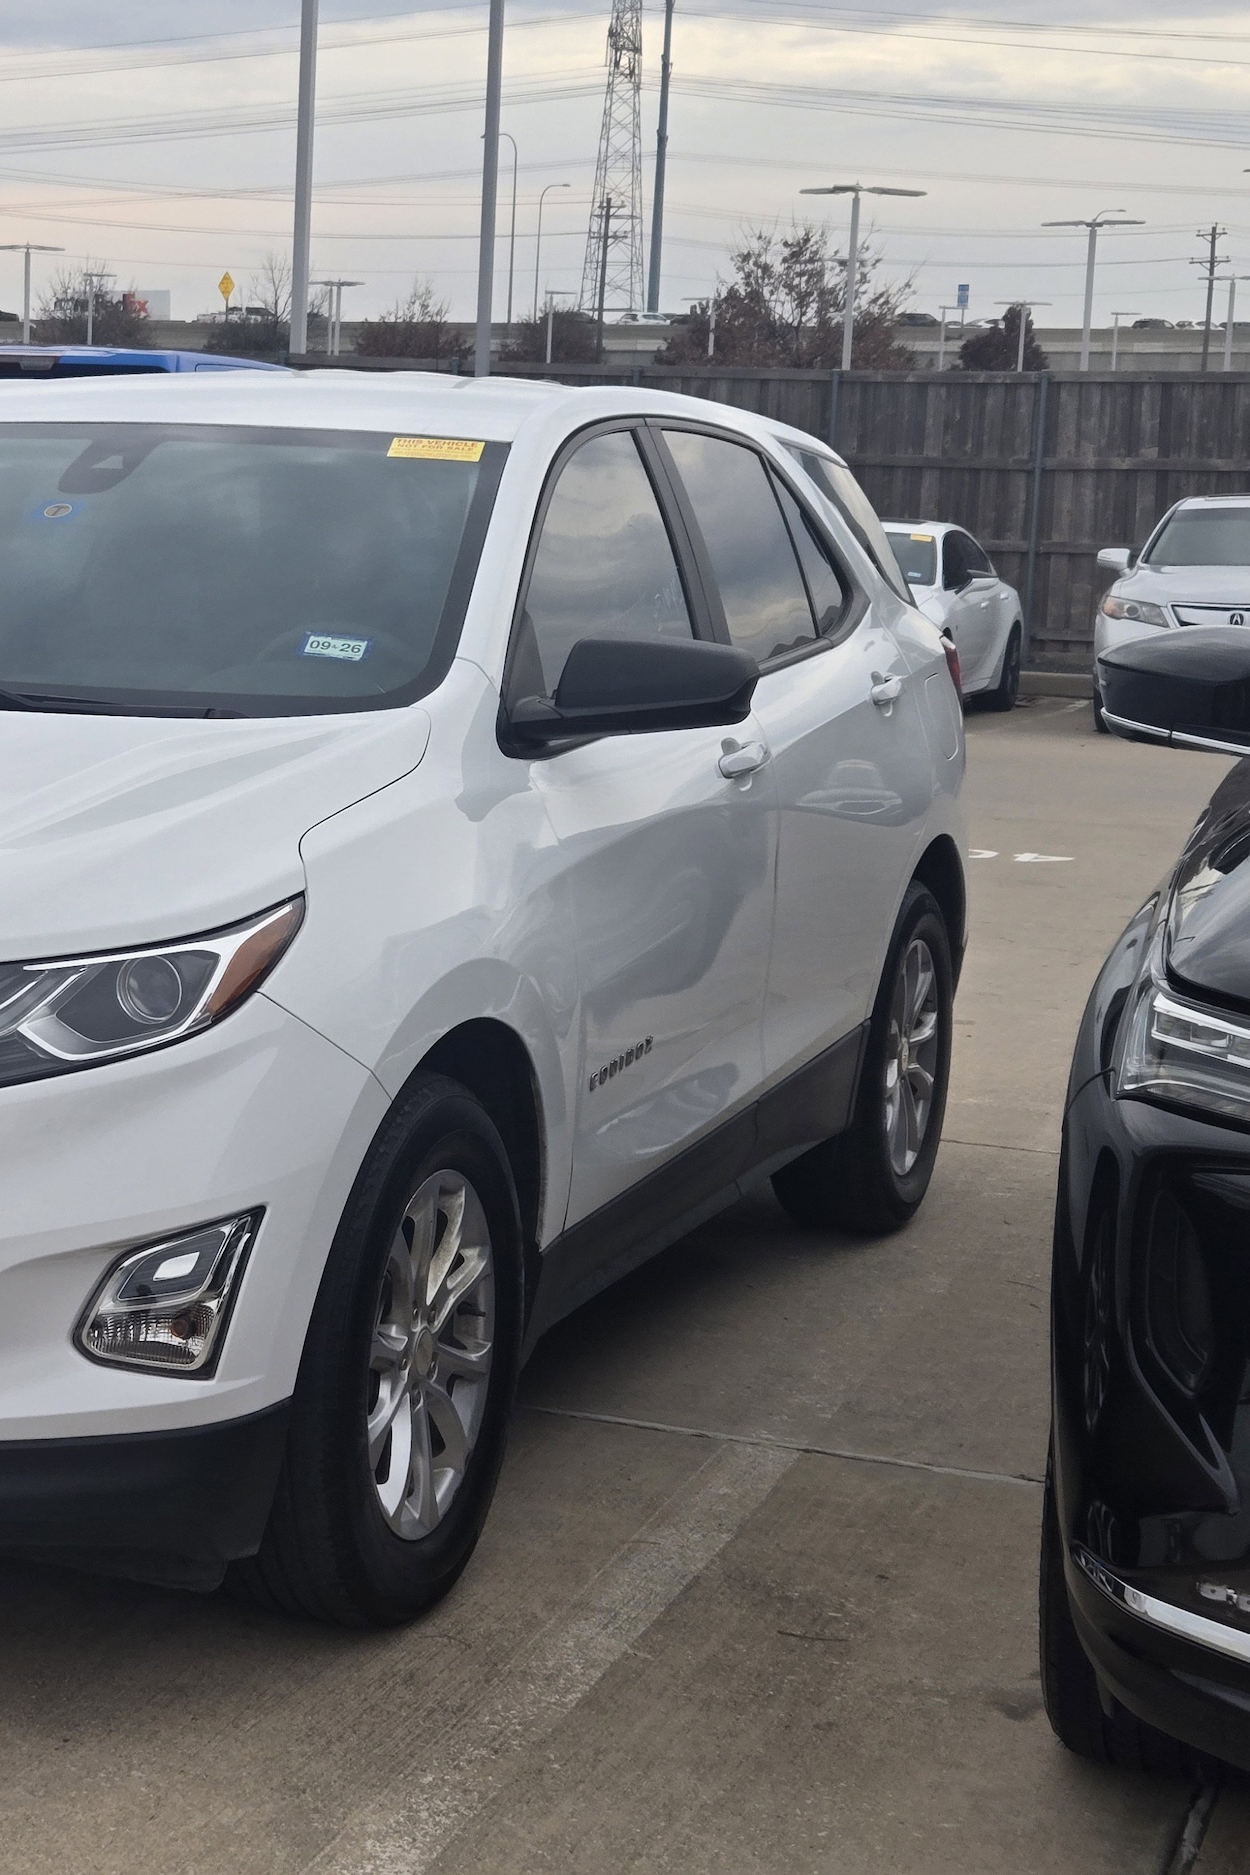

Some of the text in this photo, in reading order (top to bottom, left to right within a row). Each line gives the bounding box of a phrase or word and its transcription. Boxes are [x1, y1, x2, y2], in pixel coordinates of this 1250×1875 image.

[427, 439, 479, 448] VEHICLE
[309, 640, 362, 653] 09 26
[589, 1034, 654, 1092] EQUINOX
